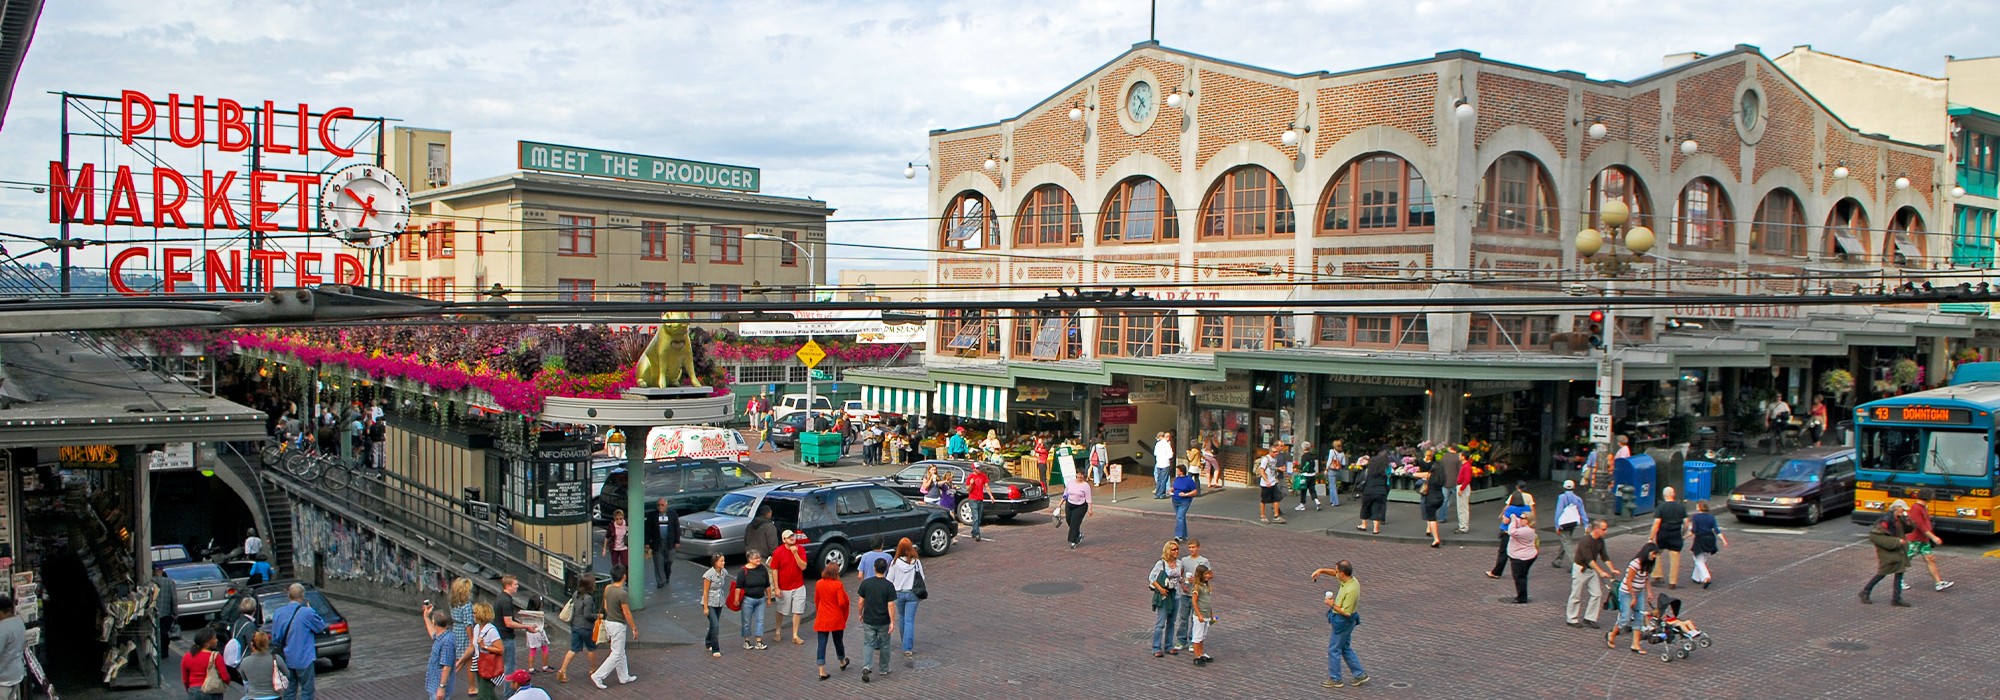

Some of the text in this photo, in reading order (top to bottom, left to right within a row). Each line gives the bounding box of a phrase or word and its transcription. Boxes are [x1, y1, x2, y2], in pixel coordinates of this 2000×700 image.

[121, 89, 354, 158] PUBLIC
[363, 168, 372, 177] 12
[531, 146, 753, 188] MEET THE PRODUCER
[332, 184, 341, 193] 10
[396, 187, 401, 196] 2
[49, 160, 321, 232] MARKET
[109, 246, 365, 302] CENTER
[1138, 292, 1219, 300] ARKET
[1743, 304, 1800, 318] MARKET
[896, 326, 925, 334] SEASON
[1329, 374, 1425, 388] PIKE PLACE FLOWERS
[1594, 416, 1608, 424] ONE
[1875, 407, 1949, 421] 43 DOWNTOWN
[60, 445, 118, 464] NEWS
[1970, 488, 1991, 496] 4122
